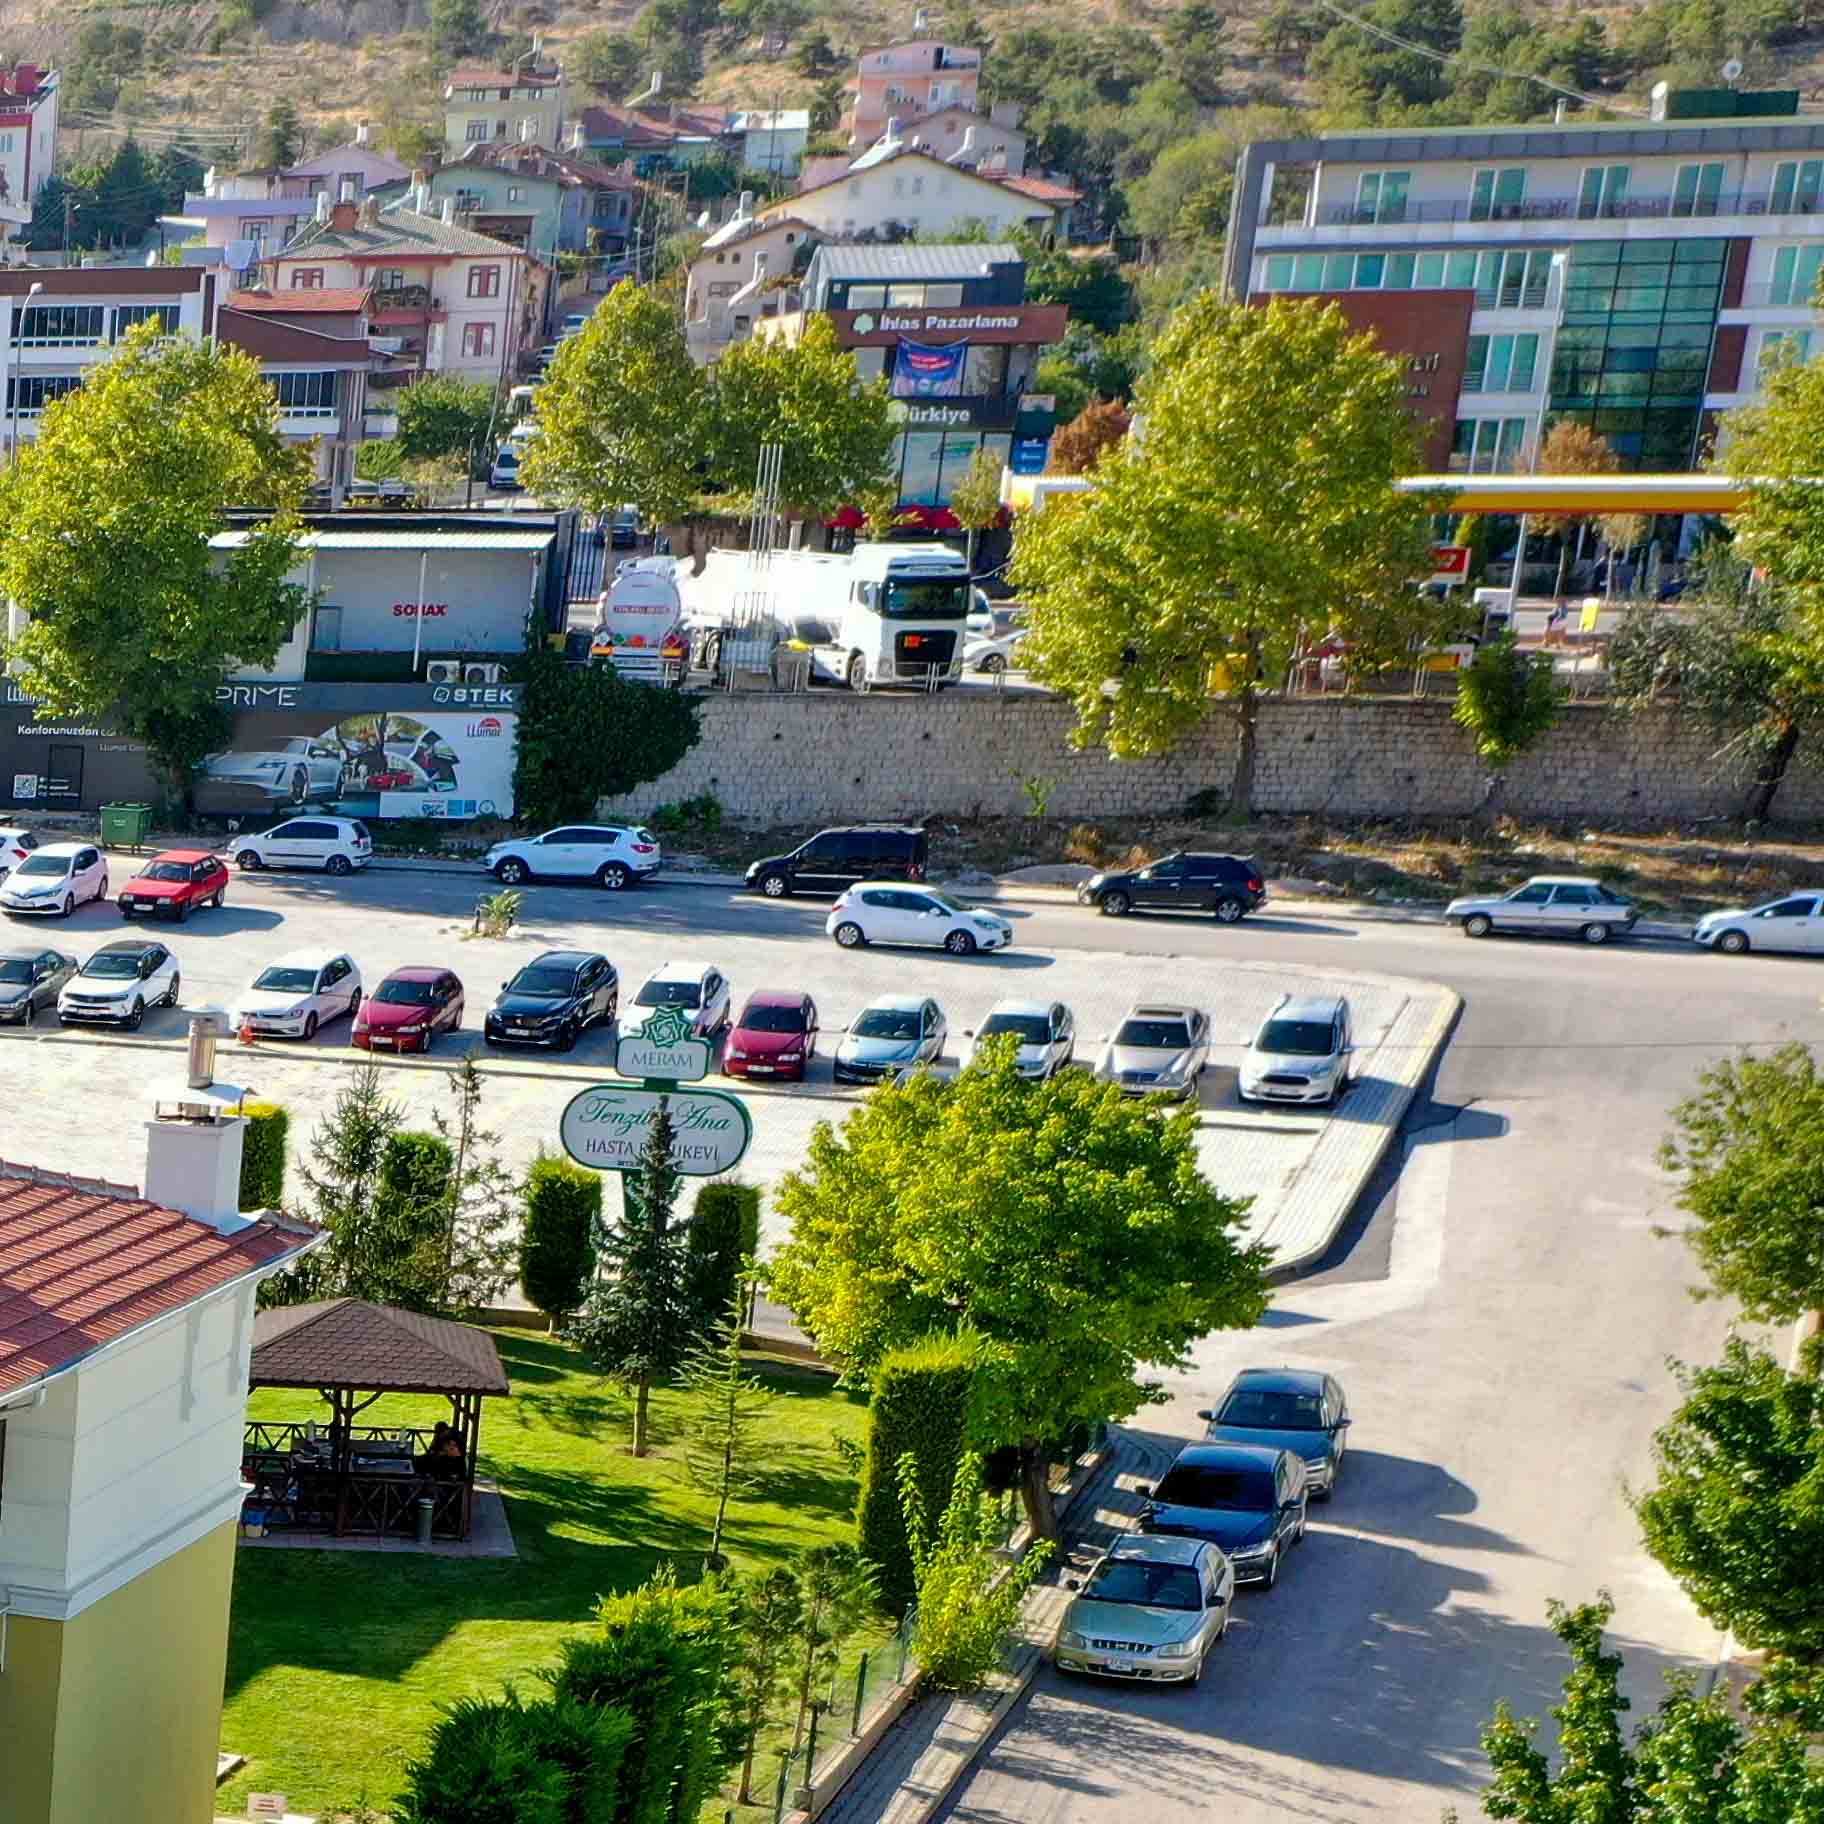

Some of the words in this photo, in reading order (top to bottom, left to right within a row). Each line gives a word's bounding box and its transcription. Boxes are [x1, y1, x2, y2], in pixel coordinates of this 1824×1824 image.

[926, 314, 1019, 329] Pazarlama
[216, 687, 297, 706] PRIME
[454, 688, 513, 702] STEK
[18, 724, 98, 736] Konforunuzdan
[631, 1051, 693, 1068] MERAM
[579, 1096, 657, 1136] Tenzil
[670, 1101, 730, 1131] Ana
[586, 1138, 633, 1154] HASTA
[639, 1142, 719, 1161] KUKEVİ
